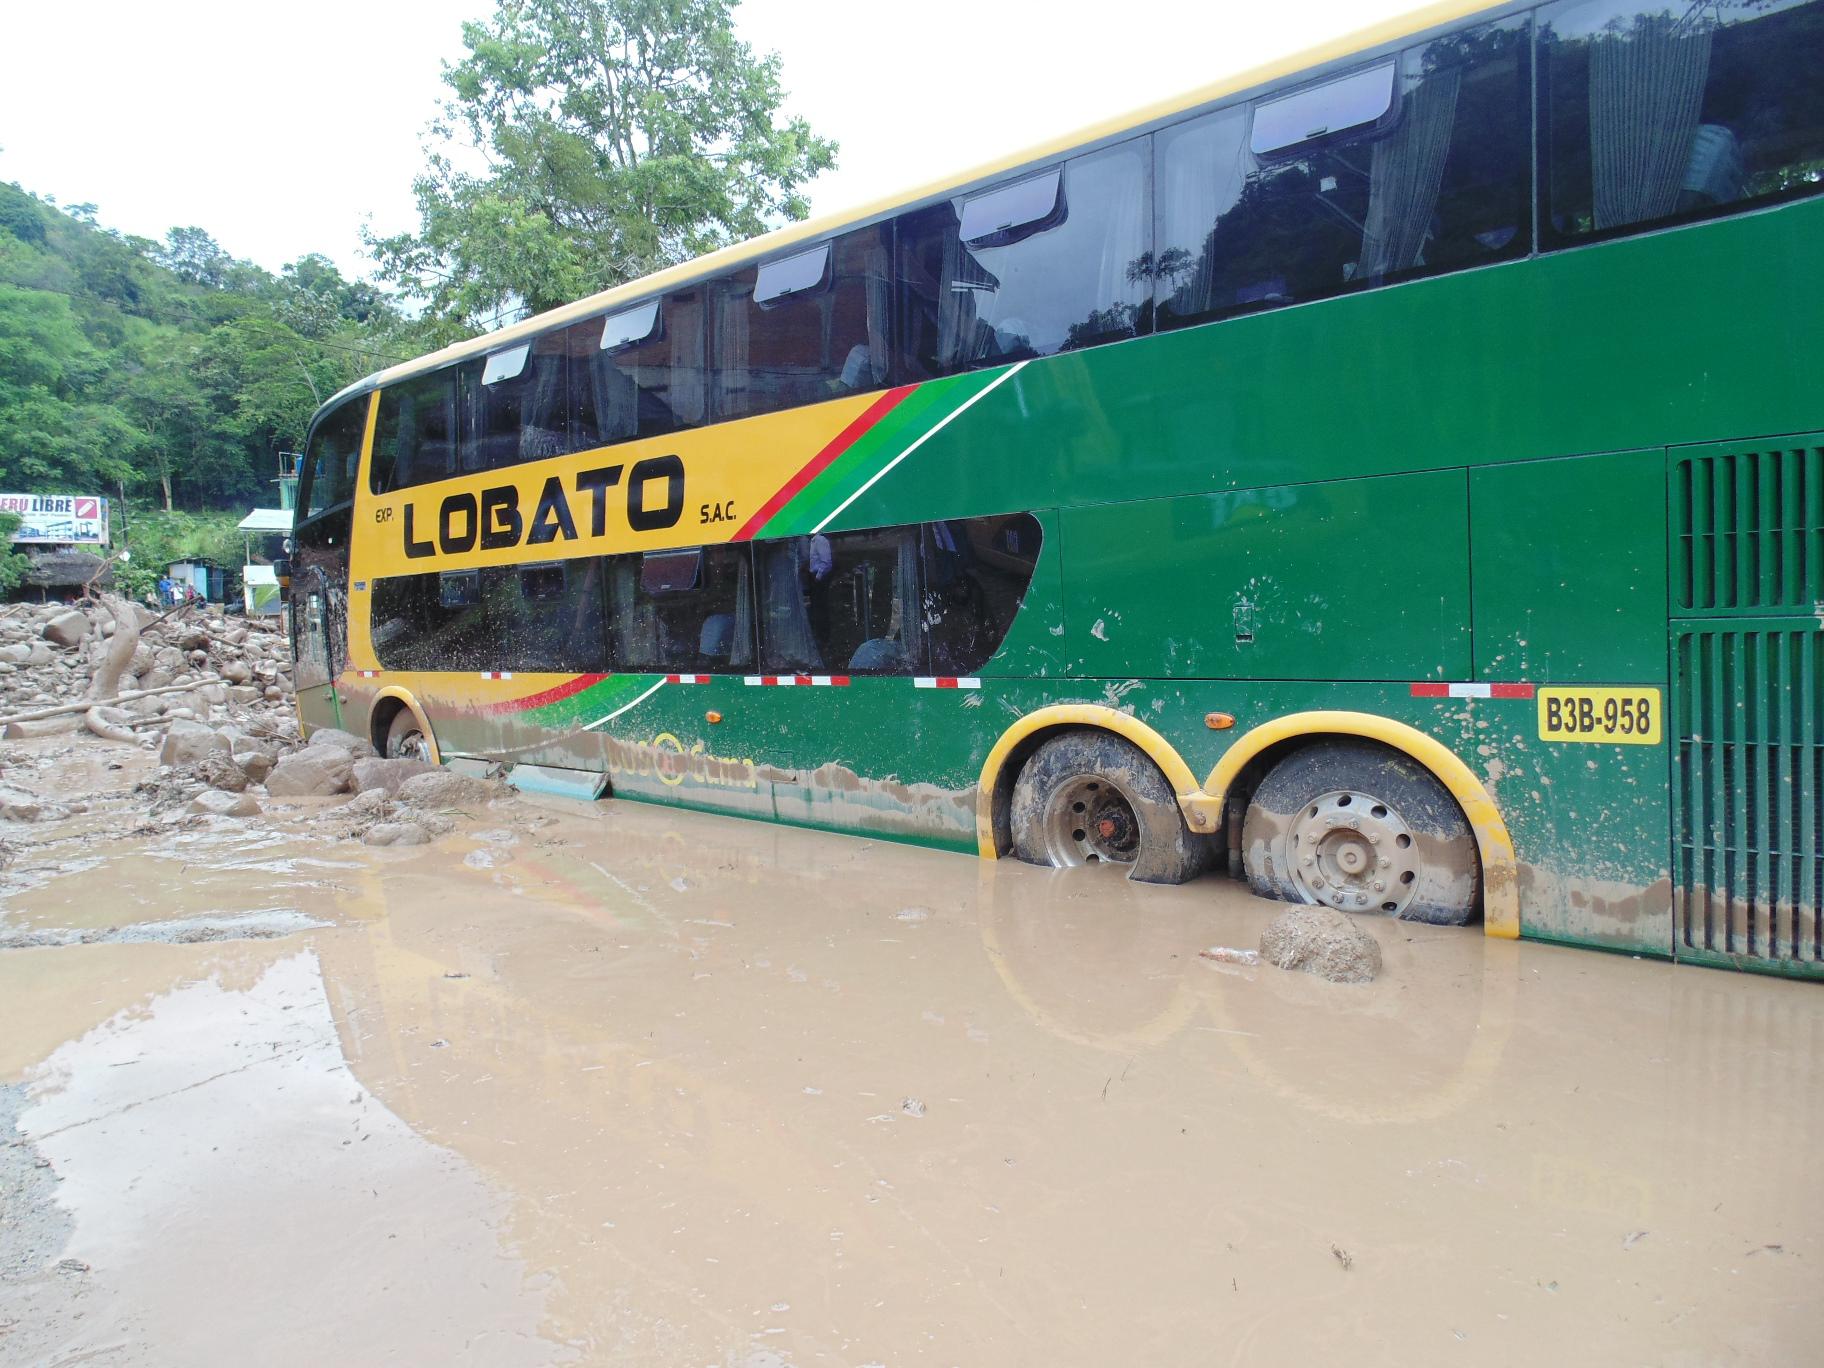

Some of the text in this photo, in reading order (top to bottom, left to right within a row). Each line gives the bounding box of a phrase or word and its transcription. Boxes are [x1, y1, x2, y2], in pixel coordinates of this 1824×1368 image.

[32, 498, 73, 513] LIBRE
[403, 454, 685, 559] LOBATO
[700, 500, 737, 524] S.A.C.
[1546, 697, 1650, 735] B3B-958
